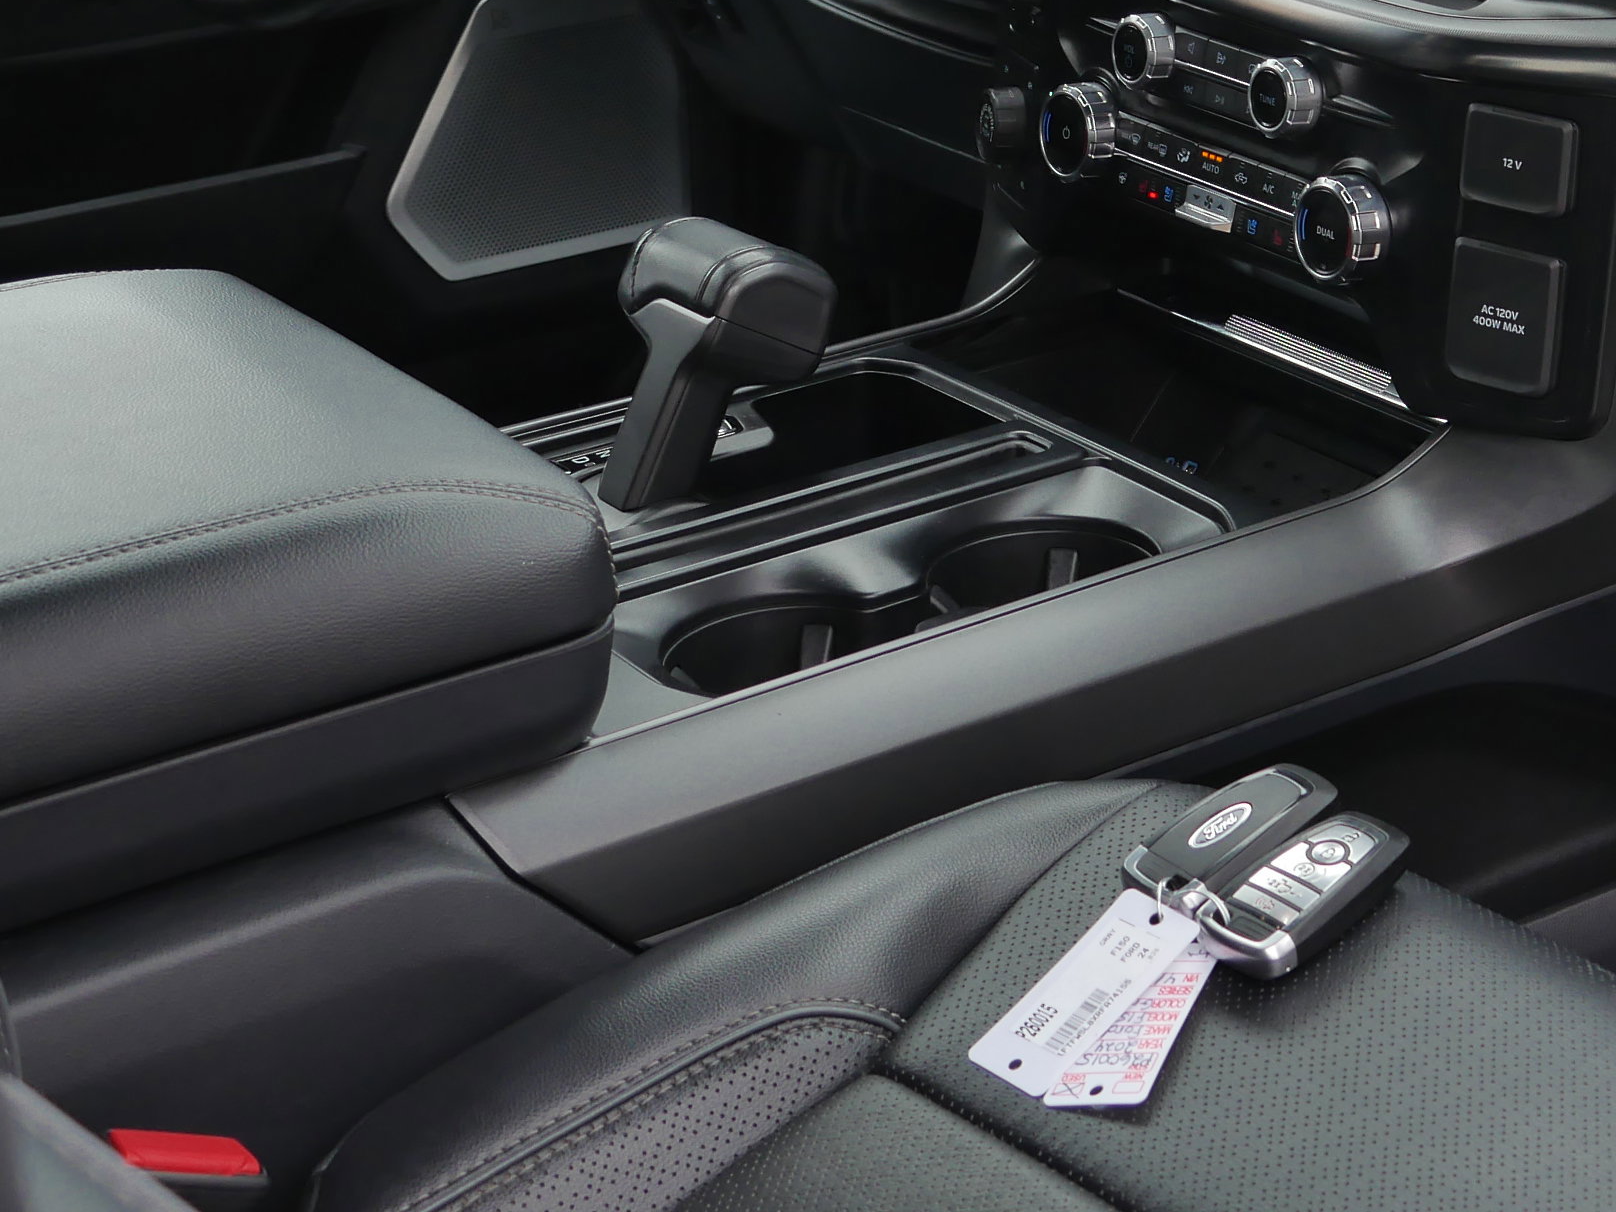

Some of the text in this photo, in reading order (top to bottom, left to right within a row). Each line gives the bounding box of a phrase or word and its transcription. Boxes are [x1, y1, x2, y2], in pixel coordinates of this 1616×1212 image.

[1259, 94, 1276, 107] TUNE
[1202, 162, 1220, 175] AUTO
[1502, 157, 1523, 170] 12 V
[1262, 183, 1275, 195] A/C
[1316, 225, 1335, 240] DUAL
[1481, 304, 1519, 321] AC 120V
[1472, 315, 1525, 335] 400W MAX
[571, 456, 590, 465] D
[1203, 811, 1239, 841] Ford
[1110, 935, 1130, 957] F150
[1120, 942, 1141, 963] FORD
[1137, 947, 1150, 959] 24
[1157, 986, 1194, 996] SERIES
[1150, 998, 1187, 1009] COLOR
[1014, 1002, 1059, 1039] P260015
[1147, 1011, 1180, 1022] MODEL
[1142, 1025, 1174, 1036] MAKE
[1094, 1038, 1138, 1054] 2024
[1136, 1039, 1164, 1050] YEAR
[1061, 1072, 1087, 1083] USED
[1123, 1072, 1145, 1081] NEW
